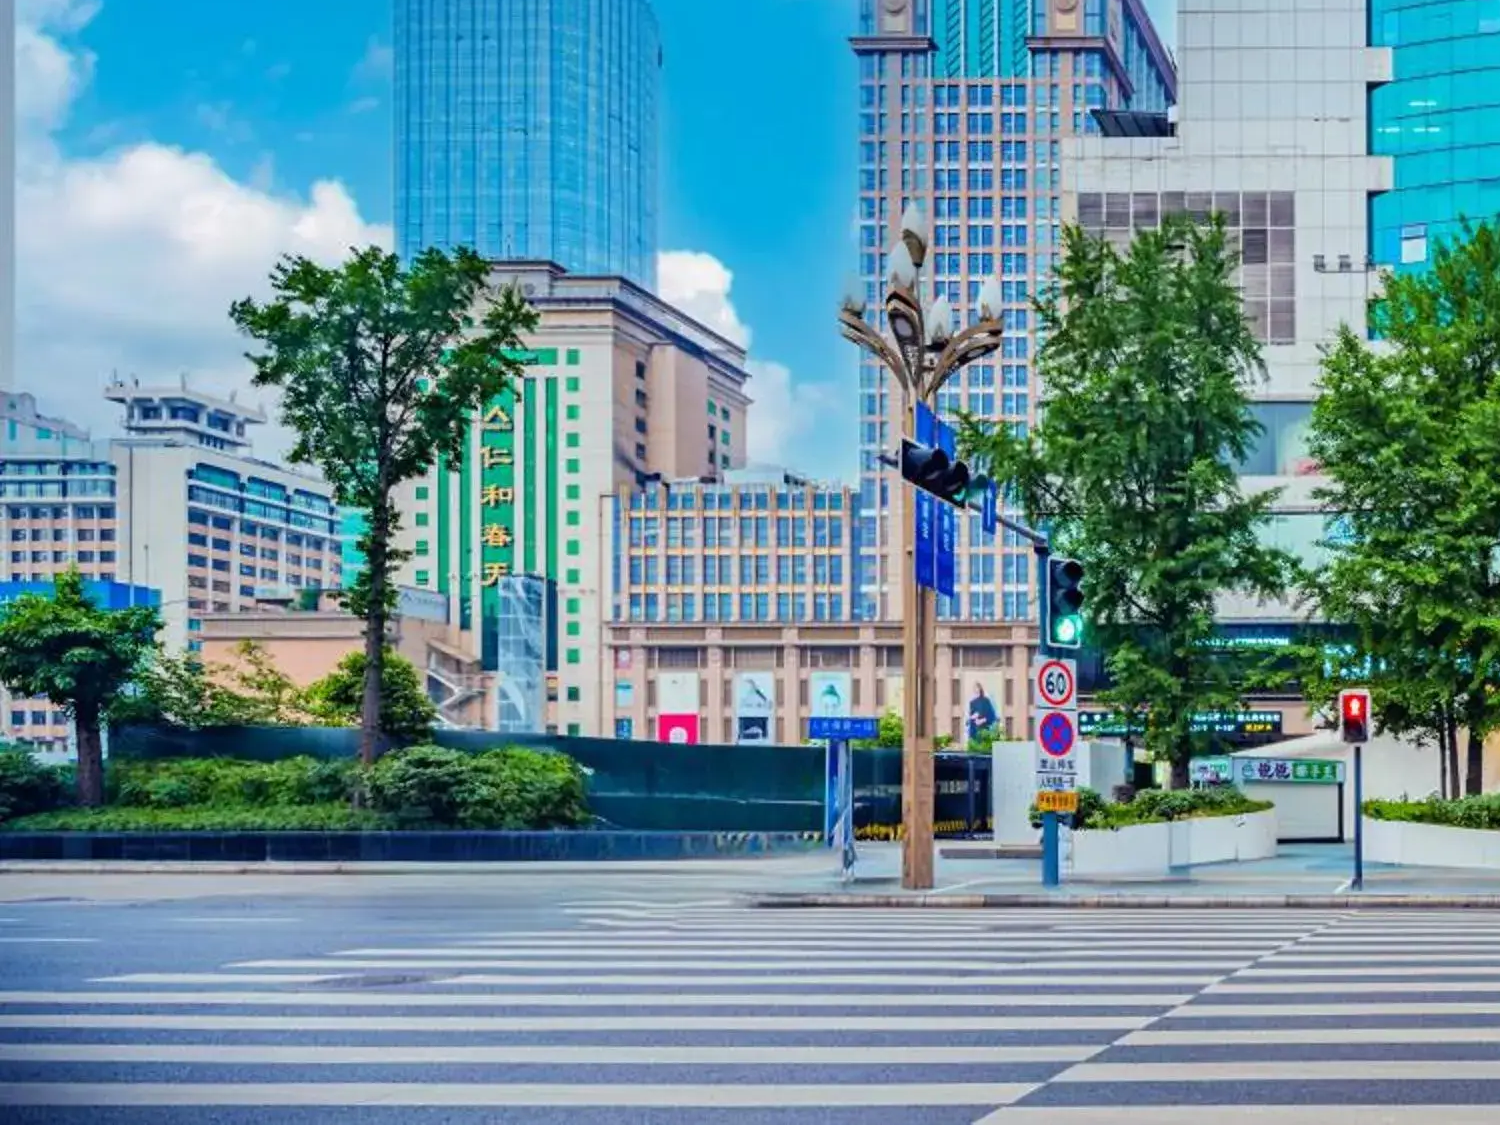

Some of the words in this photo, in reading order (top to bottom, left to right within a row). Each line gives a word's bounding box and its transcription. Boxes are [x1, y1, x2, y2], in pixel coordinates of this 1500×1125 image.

[480, 446, 514, 586] 仁和春天
[1045, 671, 1066, 696] 60
